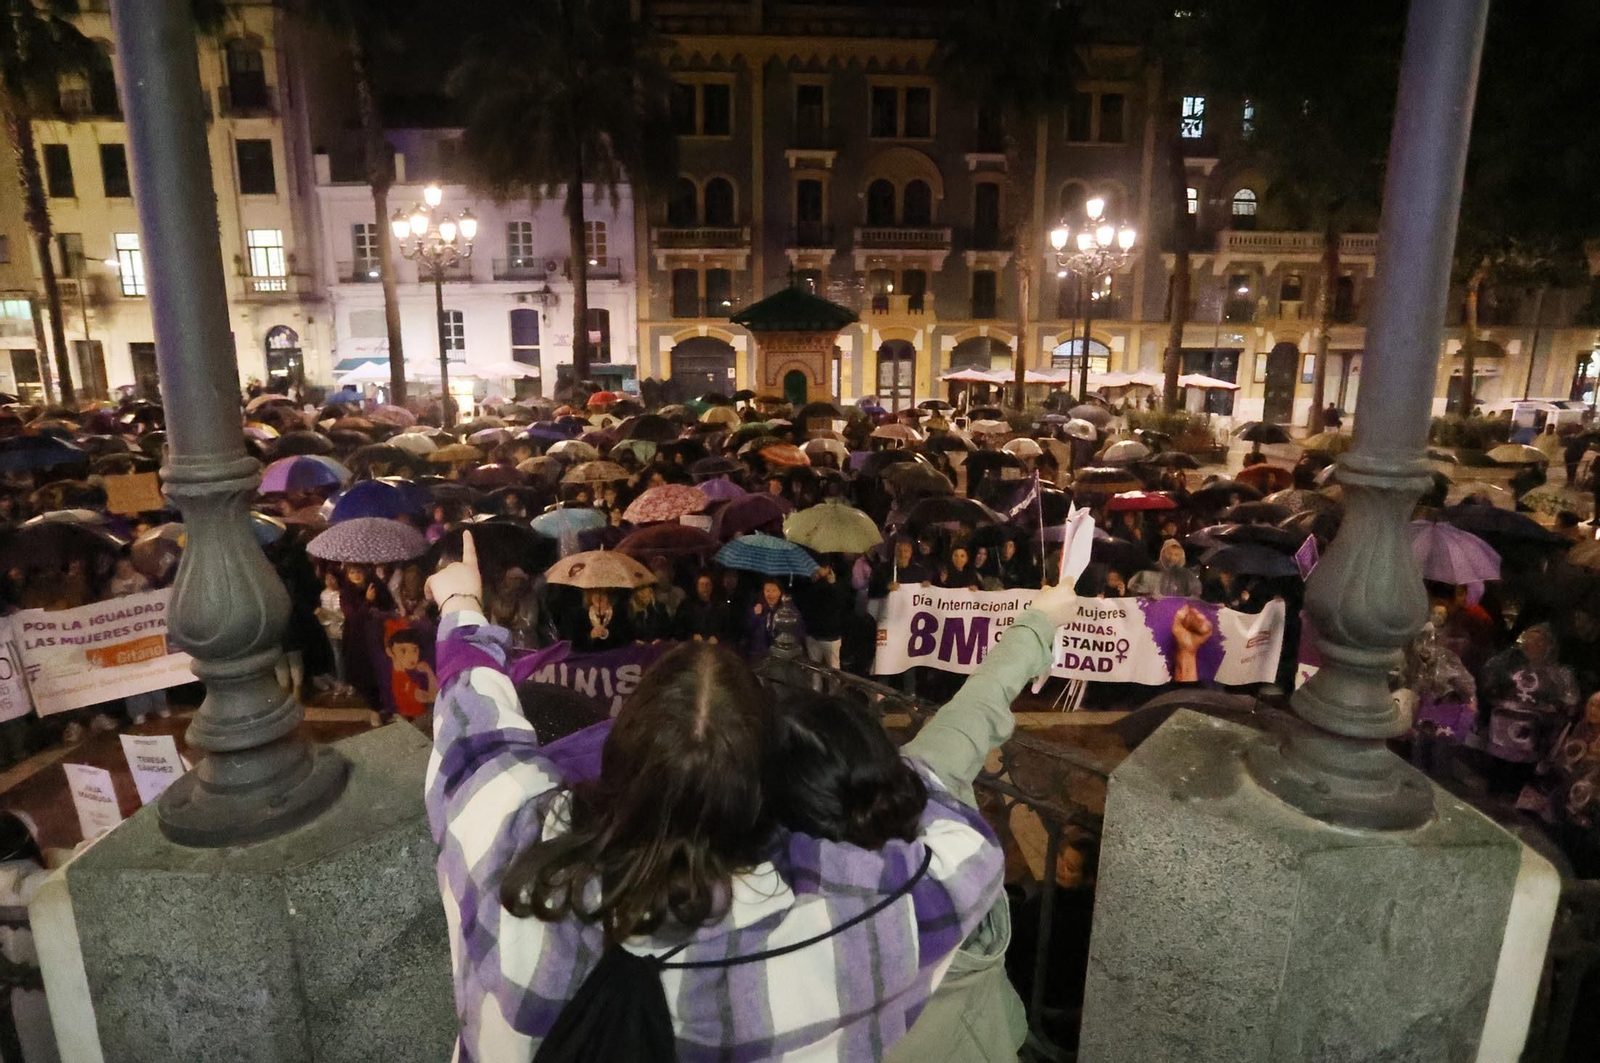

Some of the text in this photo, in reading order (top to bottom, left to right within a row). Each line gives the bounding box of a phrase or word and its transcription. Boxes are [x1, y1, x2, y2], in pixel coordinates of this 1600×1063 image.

[913, 594, 932, 607] Día
[937, 598, 1018, 612] Internacional
[23, 602, 165, 632] POR LA IGUALDAD
[25, 637, 55, 650] LAS
[60, 626, 130, 645] MUJERES
[907, 611, 991, 665] 8M
